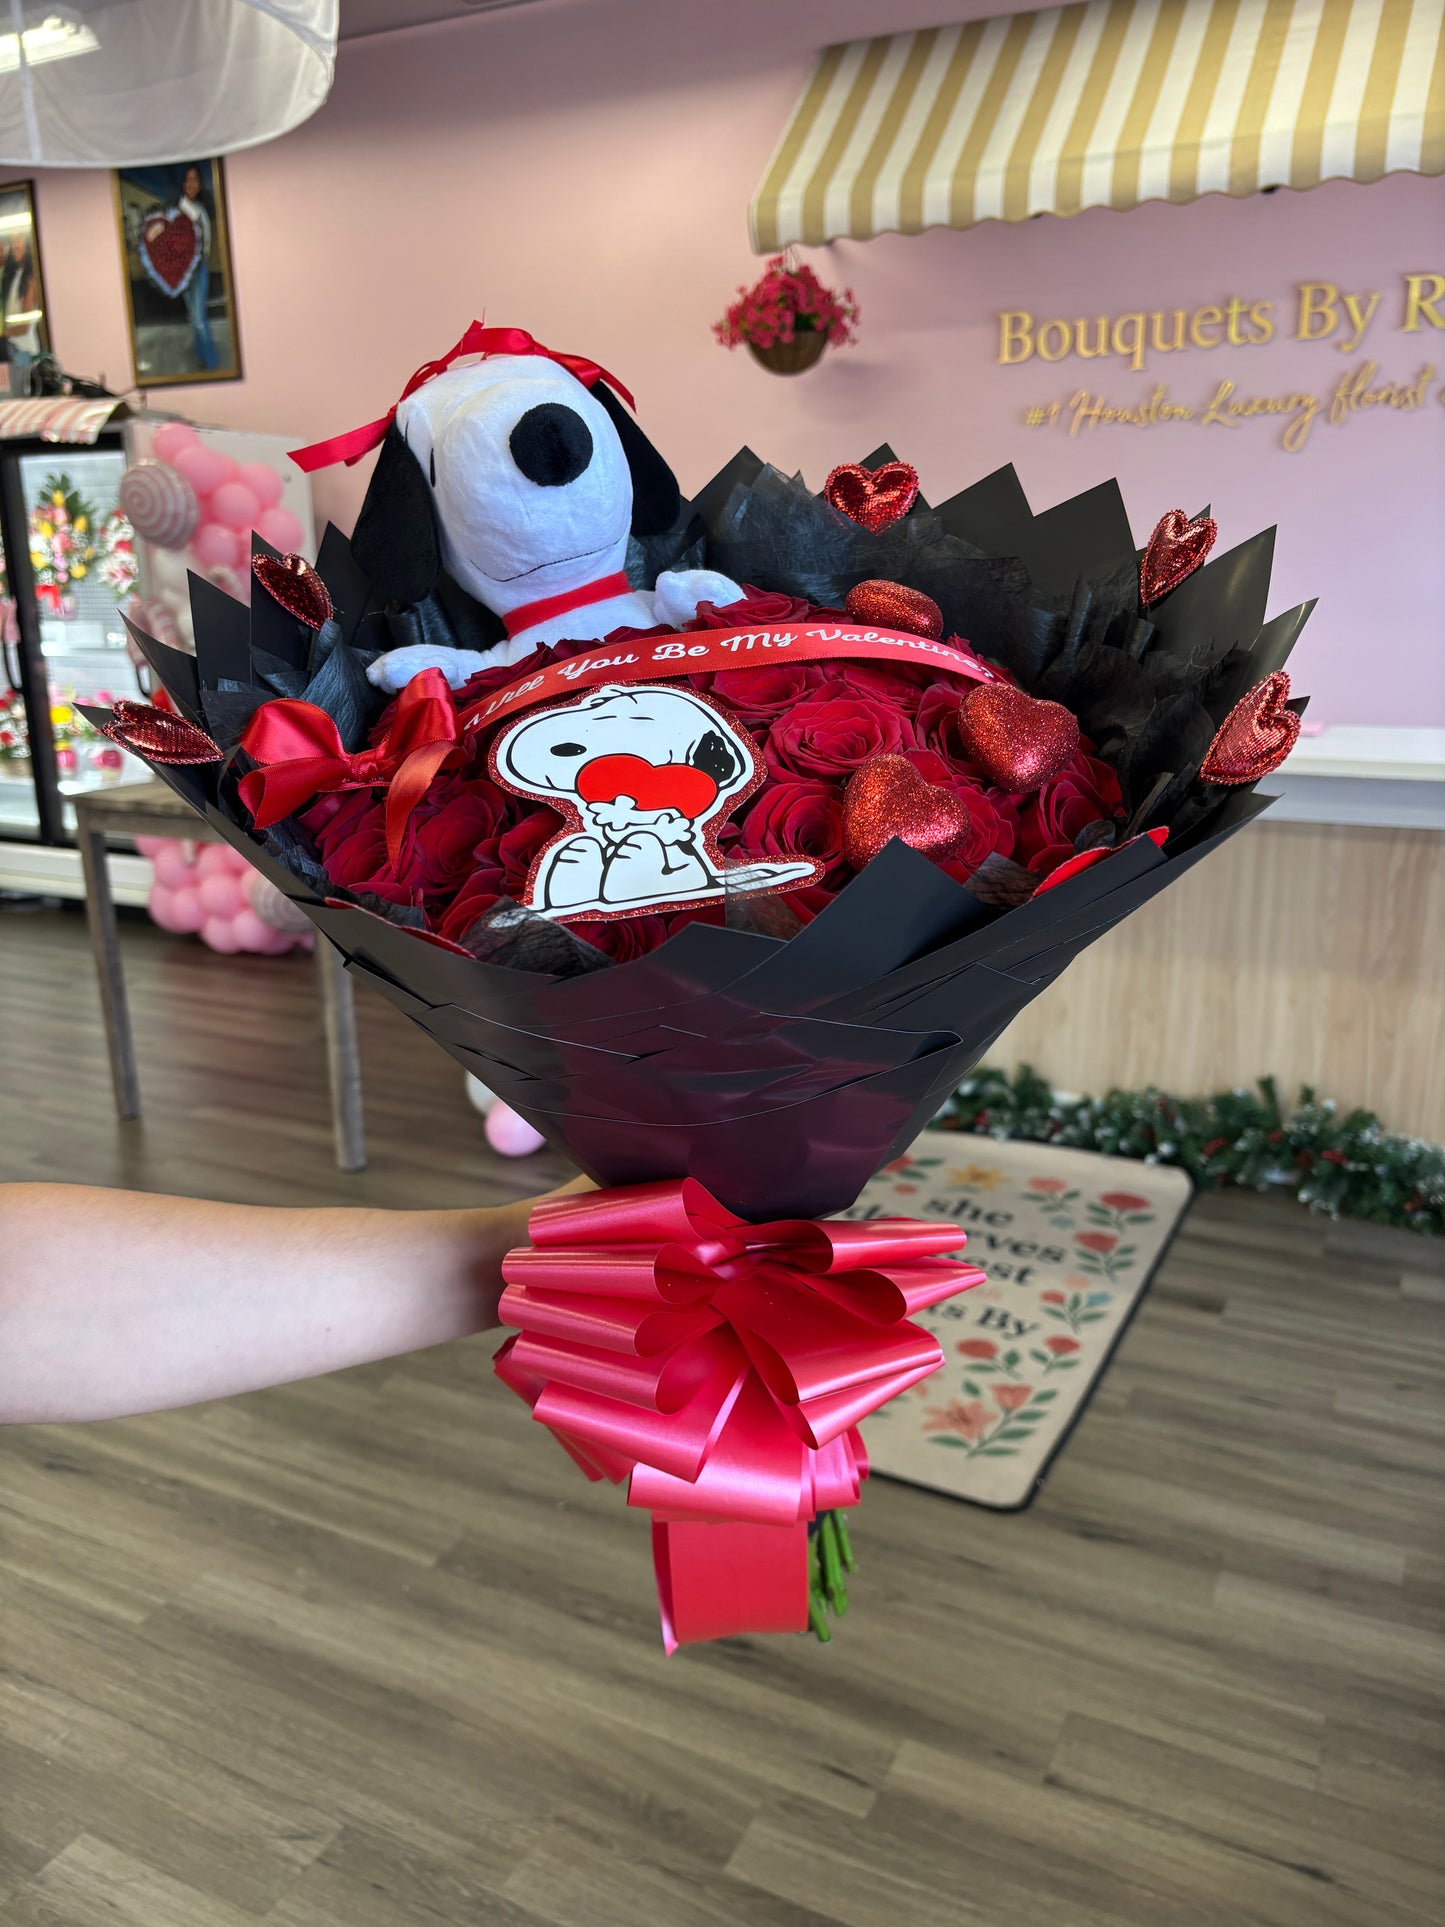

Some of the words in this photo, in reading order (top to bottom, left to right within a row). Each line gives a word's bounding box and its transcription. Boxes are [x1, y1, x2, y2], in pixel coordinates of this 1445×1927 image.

[999, 295, 1275, 371] Bouquets
[1295, 281, 1381, 353] By
[1026, 402, 1061, 427] #1
[1069, 384, 1195, 437] Houston
[1202, 380, 1321, 452] Luxury
[463, 675, 545, 731] Will
[557, 653, 640, 680] You
[651, 643, 710, 660] Be
[720, 632, 798, 652] My
[805, 629, 995, 678] Valentine?
[922, 1199, 1014, 1227] she
[977, 1306, 1042, 1339] By
